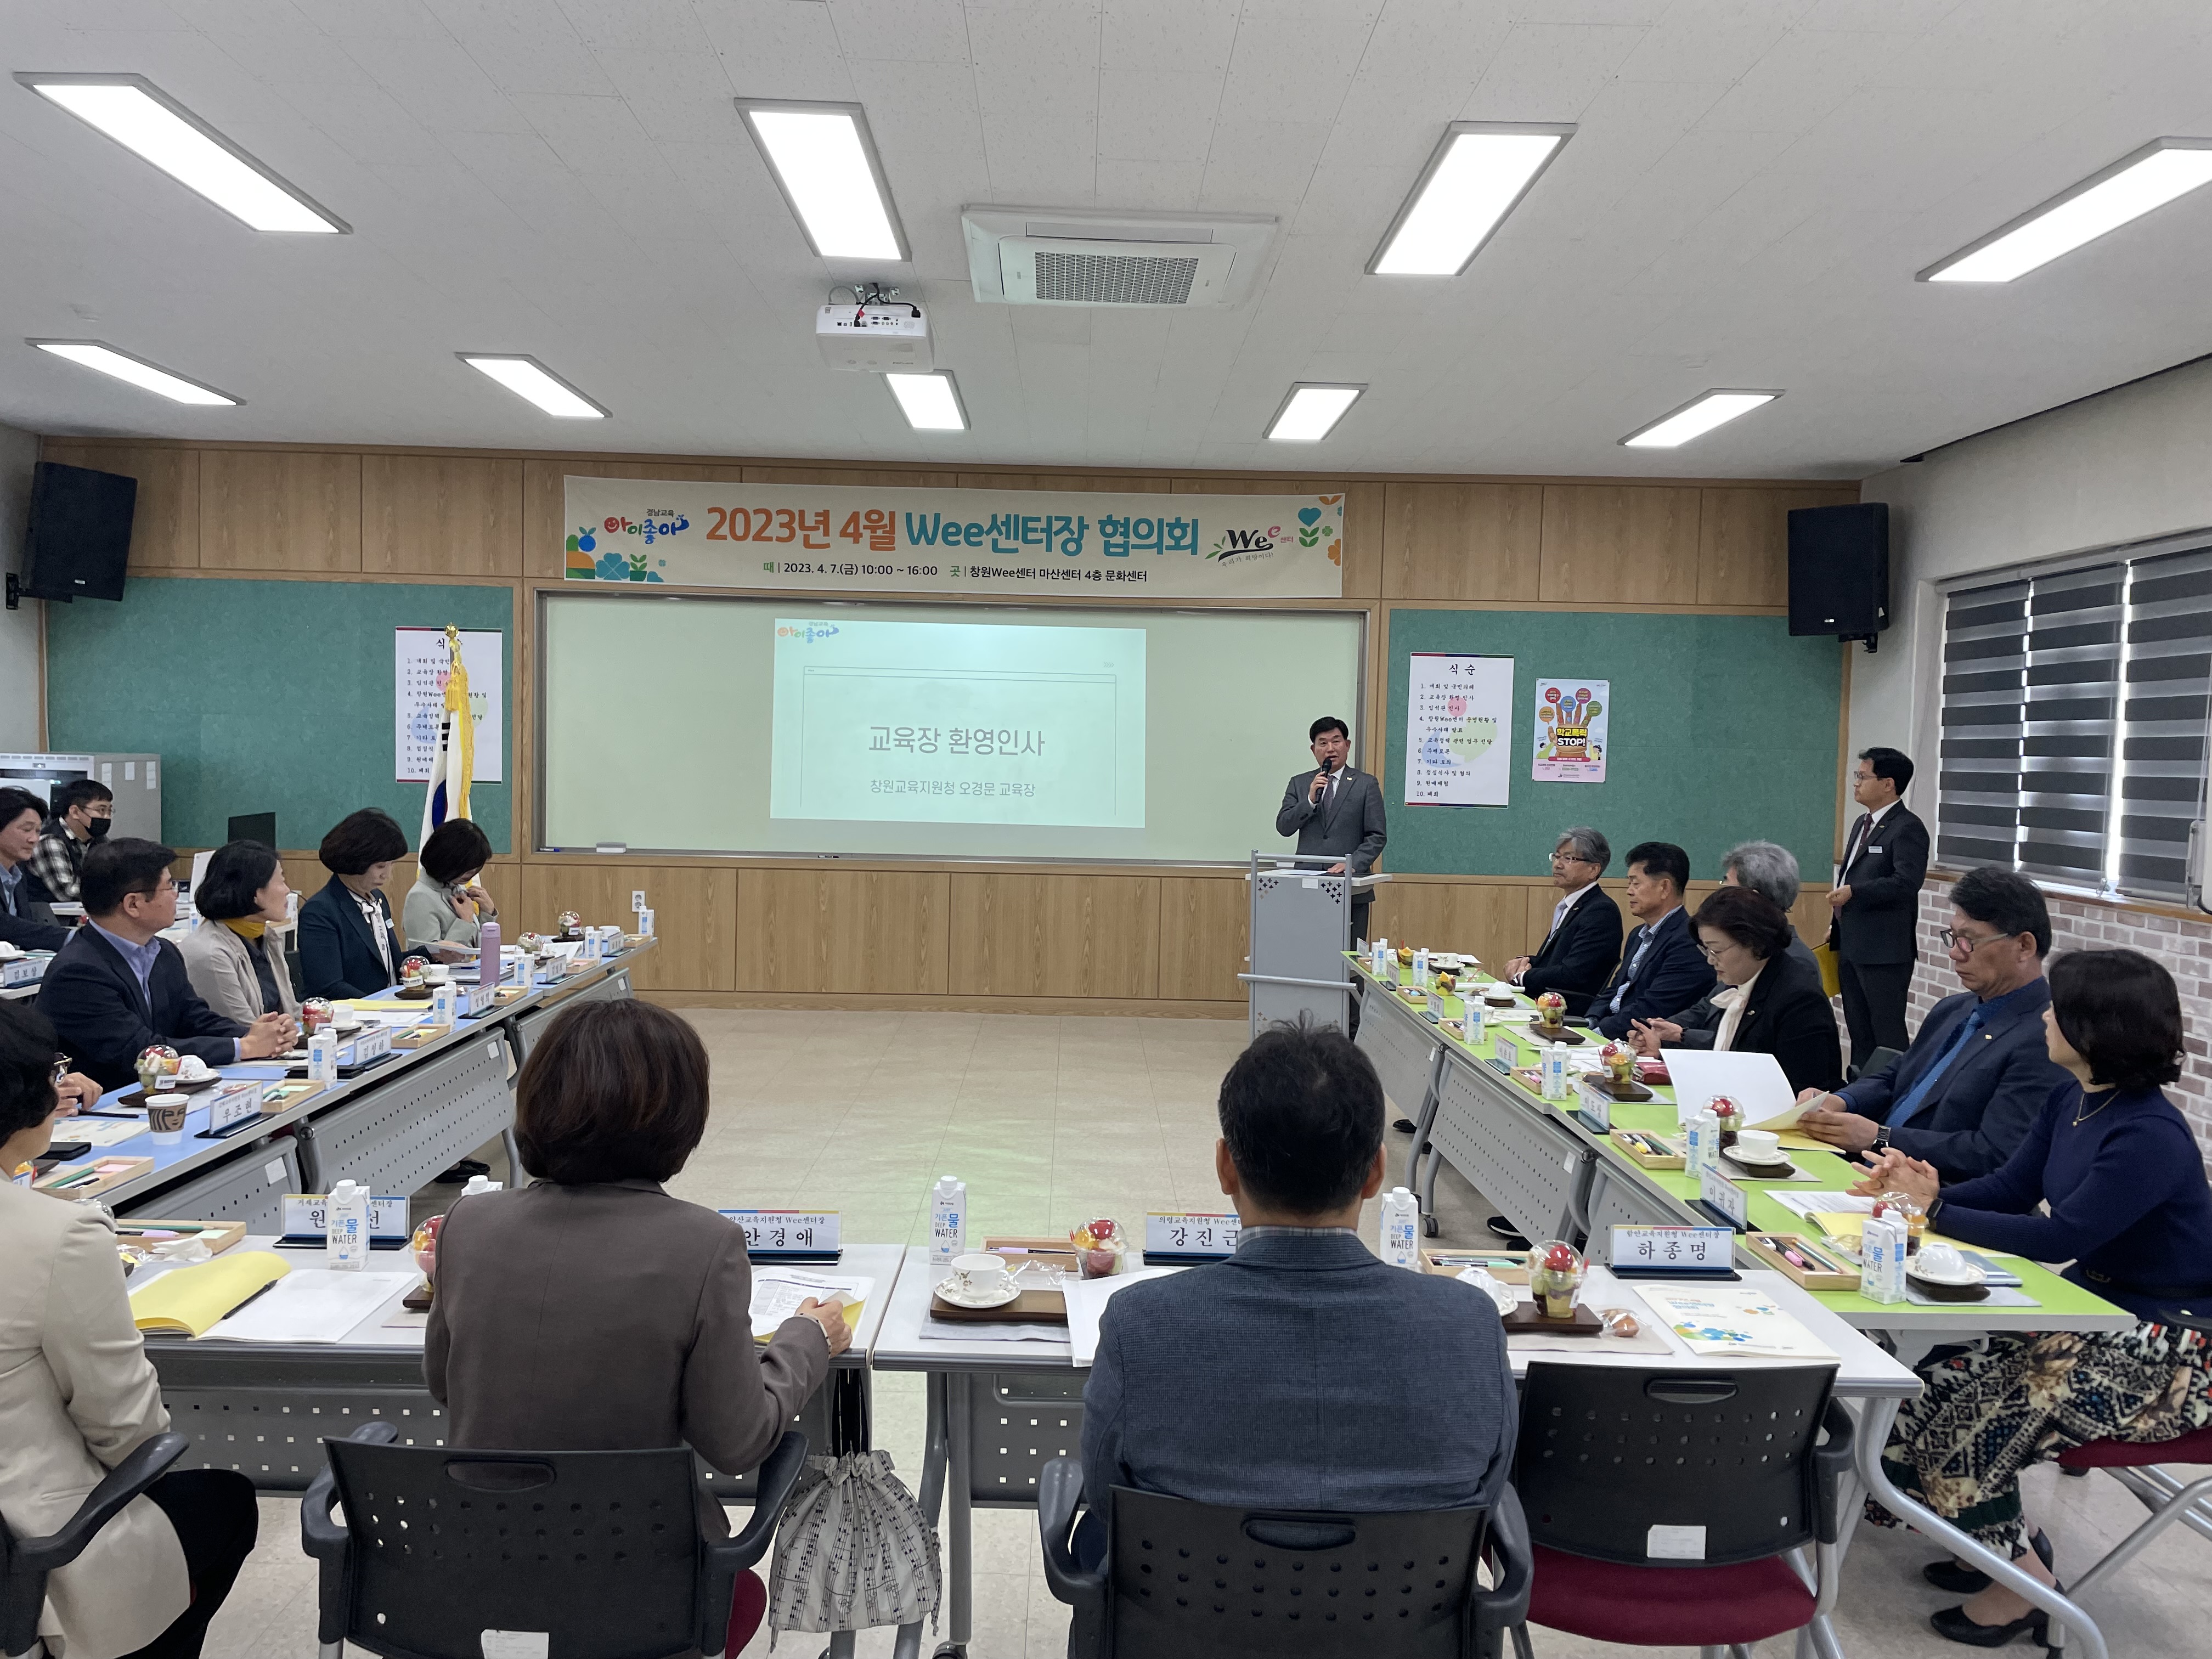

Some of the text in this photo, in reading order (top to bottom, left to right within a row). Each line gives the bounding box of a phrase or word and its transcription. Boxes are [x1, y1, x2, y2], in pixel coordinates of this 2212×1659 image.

[646, 509, 675, 517] 경남교육
[604, 514, 690, 544] 아이좋아
[706, 507, 1199, 557] 2023년 4월 Wee센터장 협의회
[763, 562, 774, 573] 때
[784, 563, 814, 573] 2023.
[817, 564, 827, 574] 4.
[862, 565, 893, 574] 10:00
[907, 566, 938, 575] 16:00
[950, 566, 1147, 582] 곳 창원Wee센터 마산센터 4층 문화센터
[777, 623, 839, 644] 아이좋아
[1556, 728, 1587, 737] 학교폭력
[868, 726, 1045, 757] 교육장 환영인사
[1557, 738, 1586, 746] STOP!
[870, 779, 1036, 797] 창원교육지원청 오경문 교육장
[785, 1216, 825, 1224] Wee센터장
[1159, 1216, 1241, 1226] 의령교육지원청 Wee센
[332, 1234, 357, 1244] WATER
[935, 1229, 958, 1238] WATER
[1627, 1229, 1678, 1238] 함안교육지원청
[1390, 1239, 1413, 1250] WATER
[1863, 1259, 1882, 1273] WATER
